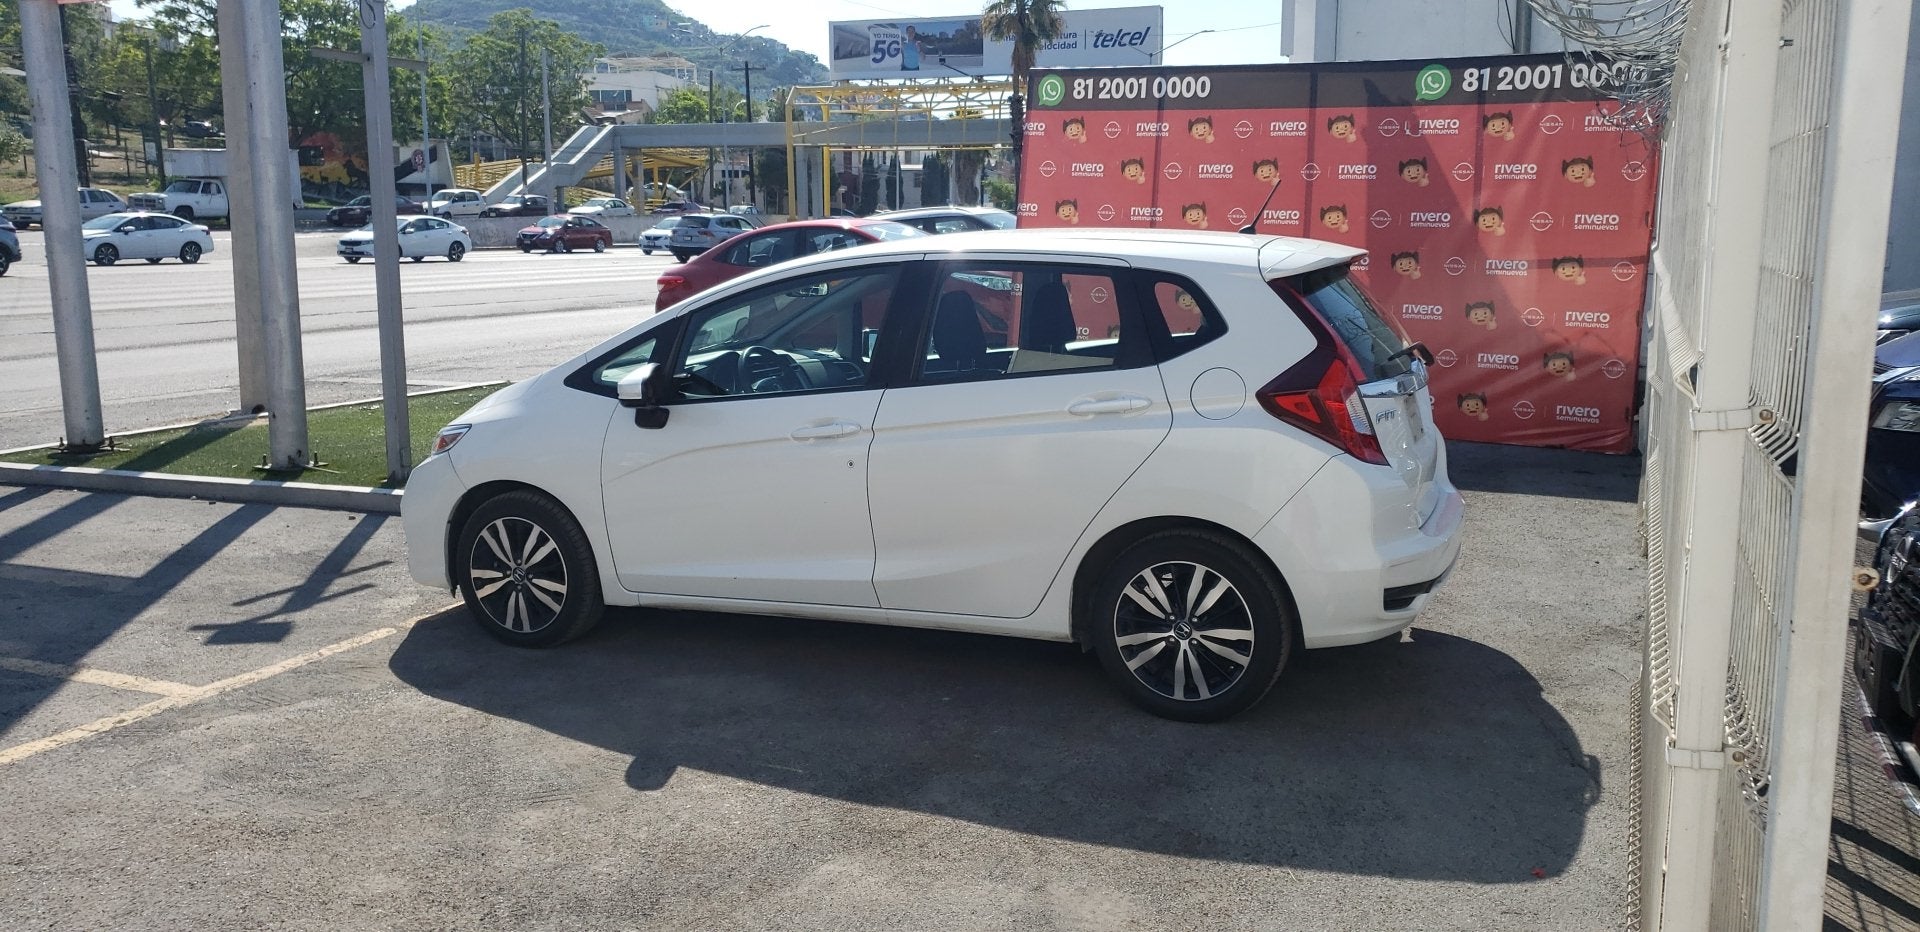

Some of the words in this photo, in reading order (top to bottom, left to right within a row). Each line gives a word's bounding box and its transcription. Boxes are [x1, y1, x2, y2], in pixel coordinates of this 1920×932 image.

[1093, 26, 1151, 48] telcel
[1040, 41, 1078, 50] elocidad
[871, 40, 900, 64] 5G
[1462, 67, 1490, 92] 81
[1496, 64, 1563, 91] 2001
[1073, 78, 1094, 99] 81
[1098, 77, 1147, 99] 2001
[1152, 75, 1211, 99] 0000
[1023, 122, 1046, 131] vero
[1136, 122, 1170, 131] rivero
[1270, 121, 1307, 131] rivero
[1419, 119, 1460, 129] rivero
[1071, 163, 1105, 172] rivero
[1198, 164, 1234, 174] rivero
[1338, 164, 1377, 174] rivero
[1494, 163, 1538, 174] rivero
[1017, 203, 1039, 212] ero
[1130, 206, 1164, 216] rivero
[1263, 209, 1300, 219] rivero
[1410, 212, 1451, 222] rivero
[1574, 214, 1620, 225] rivero
[1485, 259, 1529, 270] rivero
[1402, 304, 1443, 315] rivero
[1565, 311, 1610, 322] rivero
[1565, 321, 1610, 329] seminuevos
[1477, 353, 1520, 364] rivero
[1556, 405, 1601, 418] rivero
[1556, 414, 1600, 424] seminuevos
